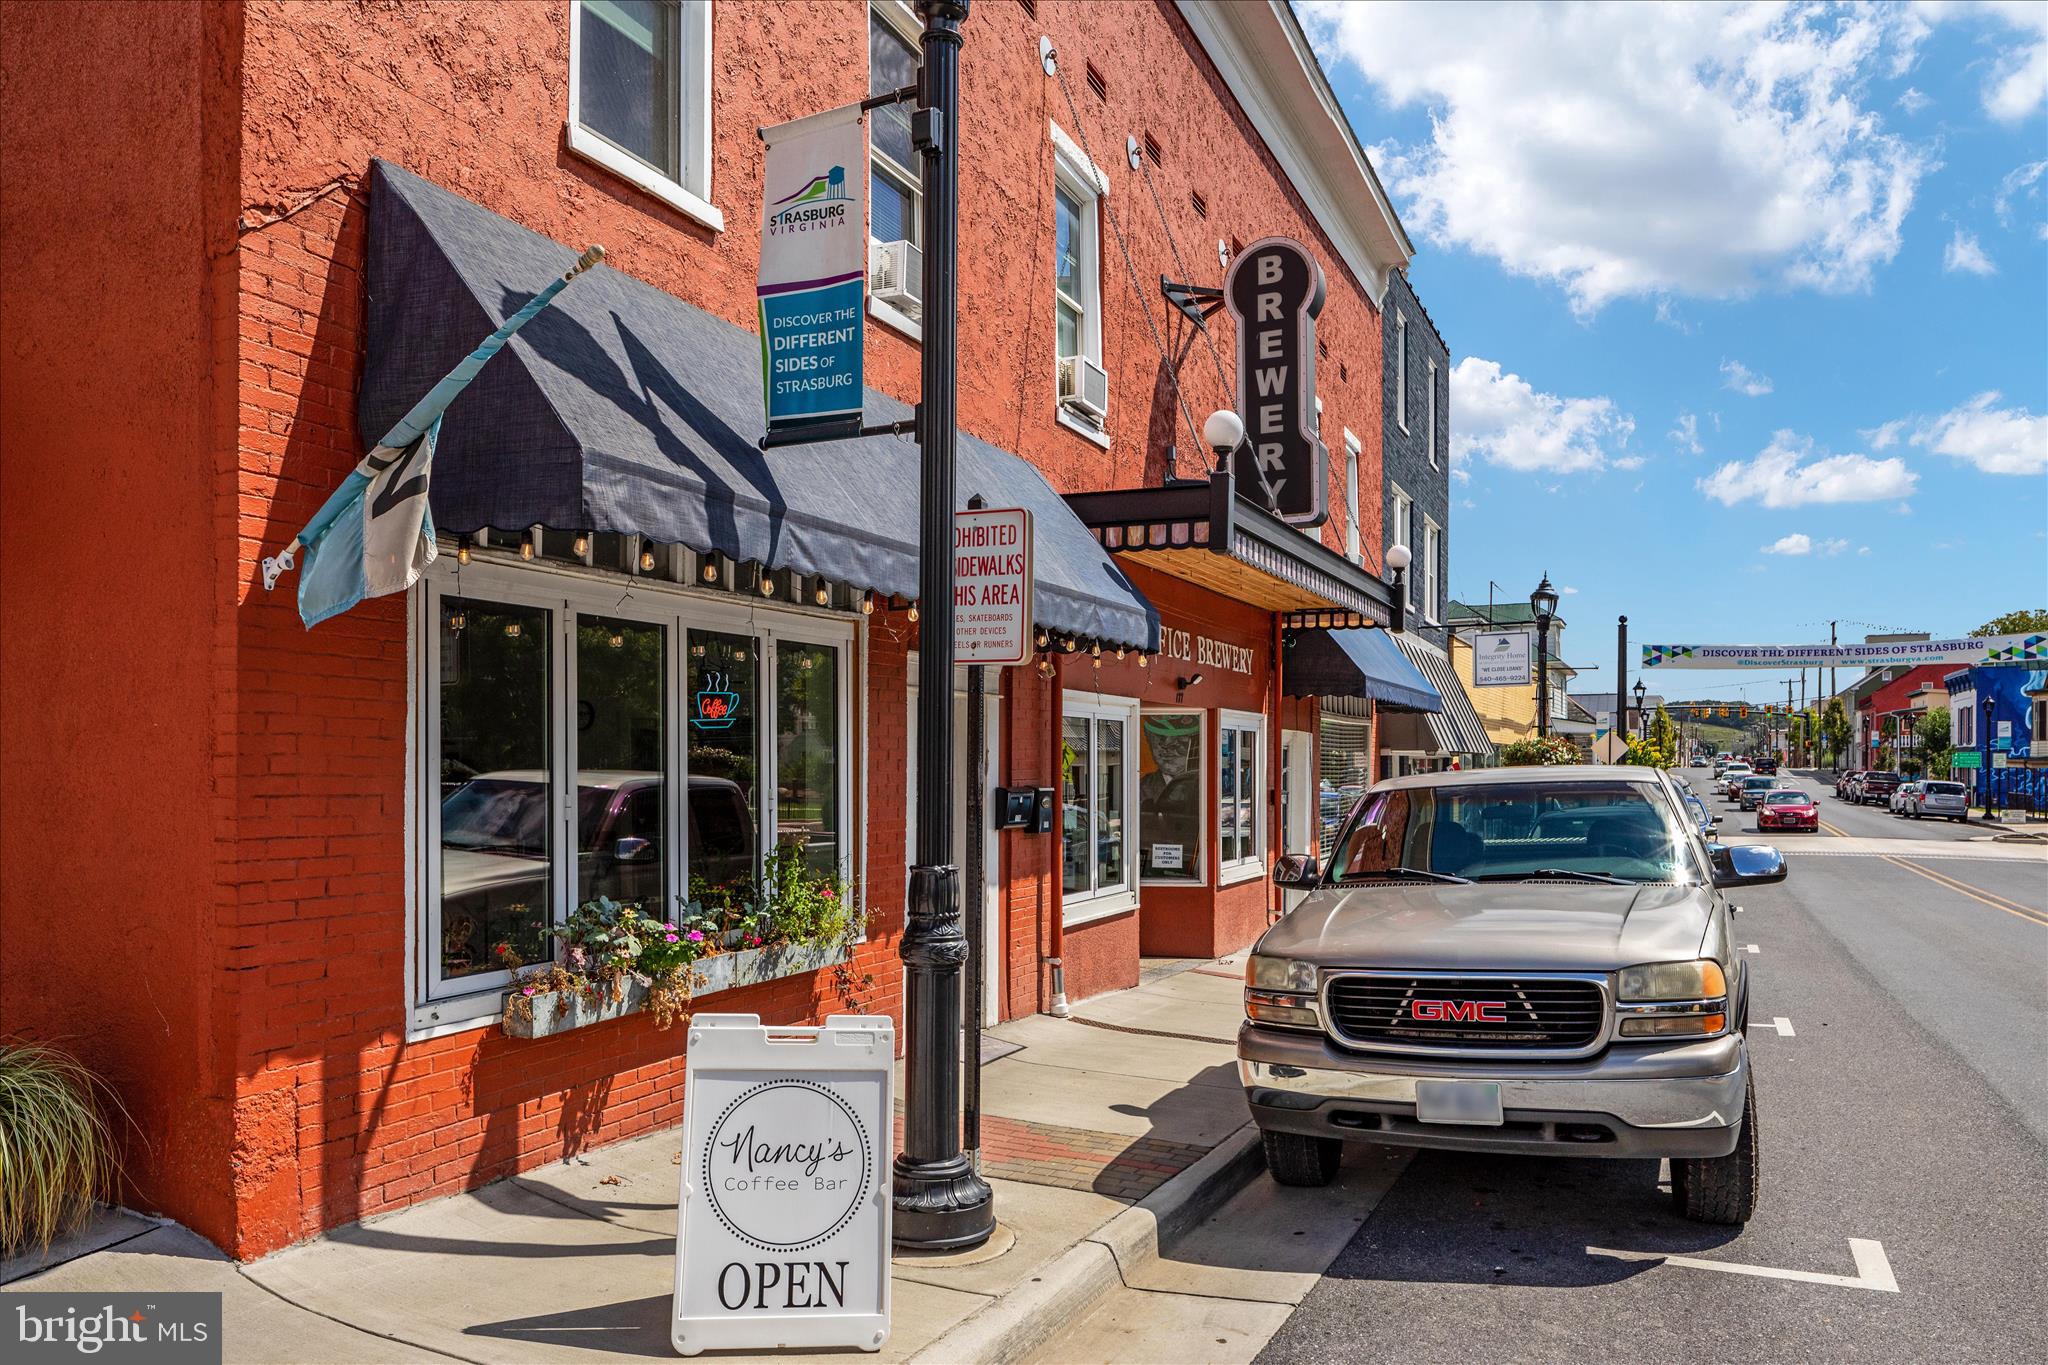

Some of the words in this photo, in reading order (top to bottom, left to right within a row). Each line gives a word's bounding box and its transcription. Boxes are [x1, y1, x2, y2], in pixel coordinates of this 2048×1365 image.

[770, 204, 844, 227] STRASBURG
[770, 217, 845, 236] VIRGINIA
[773, 312, 832, 329] DISCOVER
[834, 307, 856, 321] THE
[774, 327, 855, 351] DIFFERENT
[775, 356, 818, 373] SIDES
[820, 356, 835, 368] OF
[776, 373, 852, 394] STRASBURG
[1255, 254, 1288, 509] BREWERY
[954, 554, 1023, 577] IDEWALKS
[981, 584, 1020, 606] AREA
[969, 613, 1013, 622] SKATEBOARDS
[956, 627, 977, 636] OTHER
[980, 626, 1007, 635] DEVICES
[984, 640, 1014, 648] RUNNERS
[1702, 649, 1758, 658] DISCOVER
[1761, 648, 1784, 657] THE
[1787, 648, 1852, 657] DIFFERENT
[1855, 646, 1889, 656] SIDES
[1891, 646, 1907, 655] OF
[1910, 641, 1984, 653] STRASBURG
[1197, 635, 1254, 675] BREWERY
[1737, 659, 1824, 667] @DiscoverStrasburg
[1841, 655, 1943, 665] www.strasburgva.com
[702, 698, 727, 719] Coffee
[1412, 999, 1507, 1023] GMC
[720, 1124, 854, 1177] Nancy's
[725, 1176, 799, 1191] Coffee
[814, 1176, 848, 1191] Bar
[717, 1261, 850, 1311] OPEN
